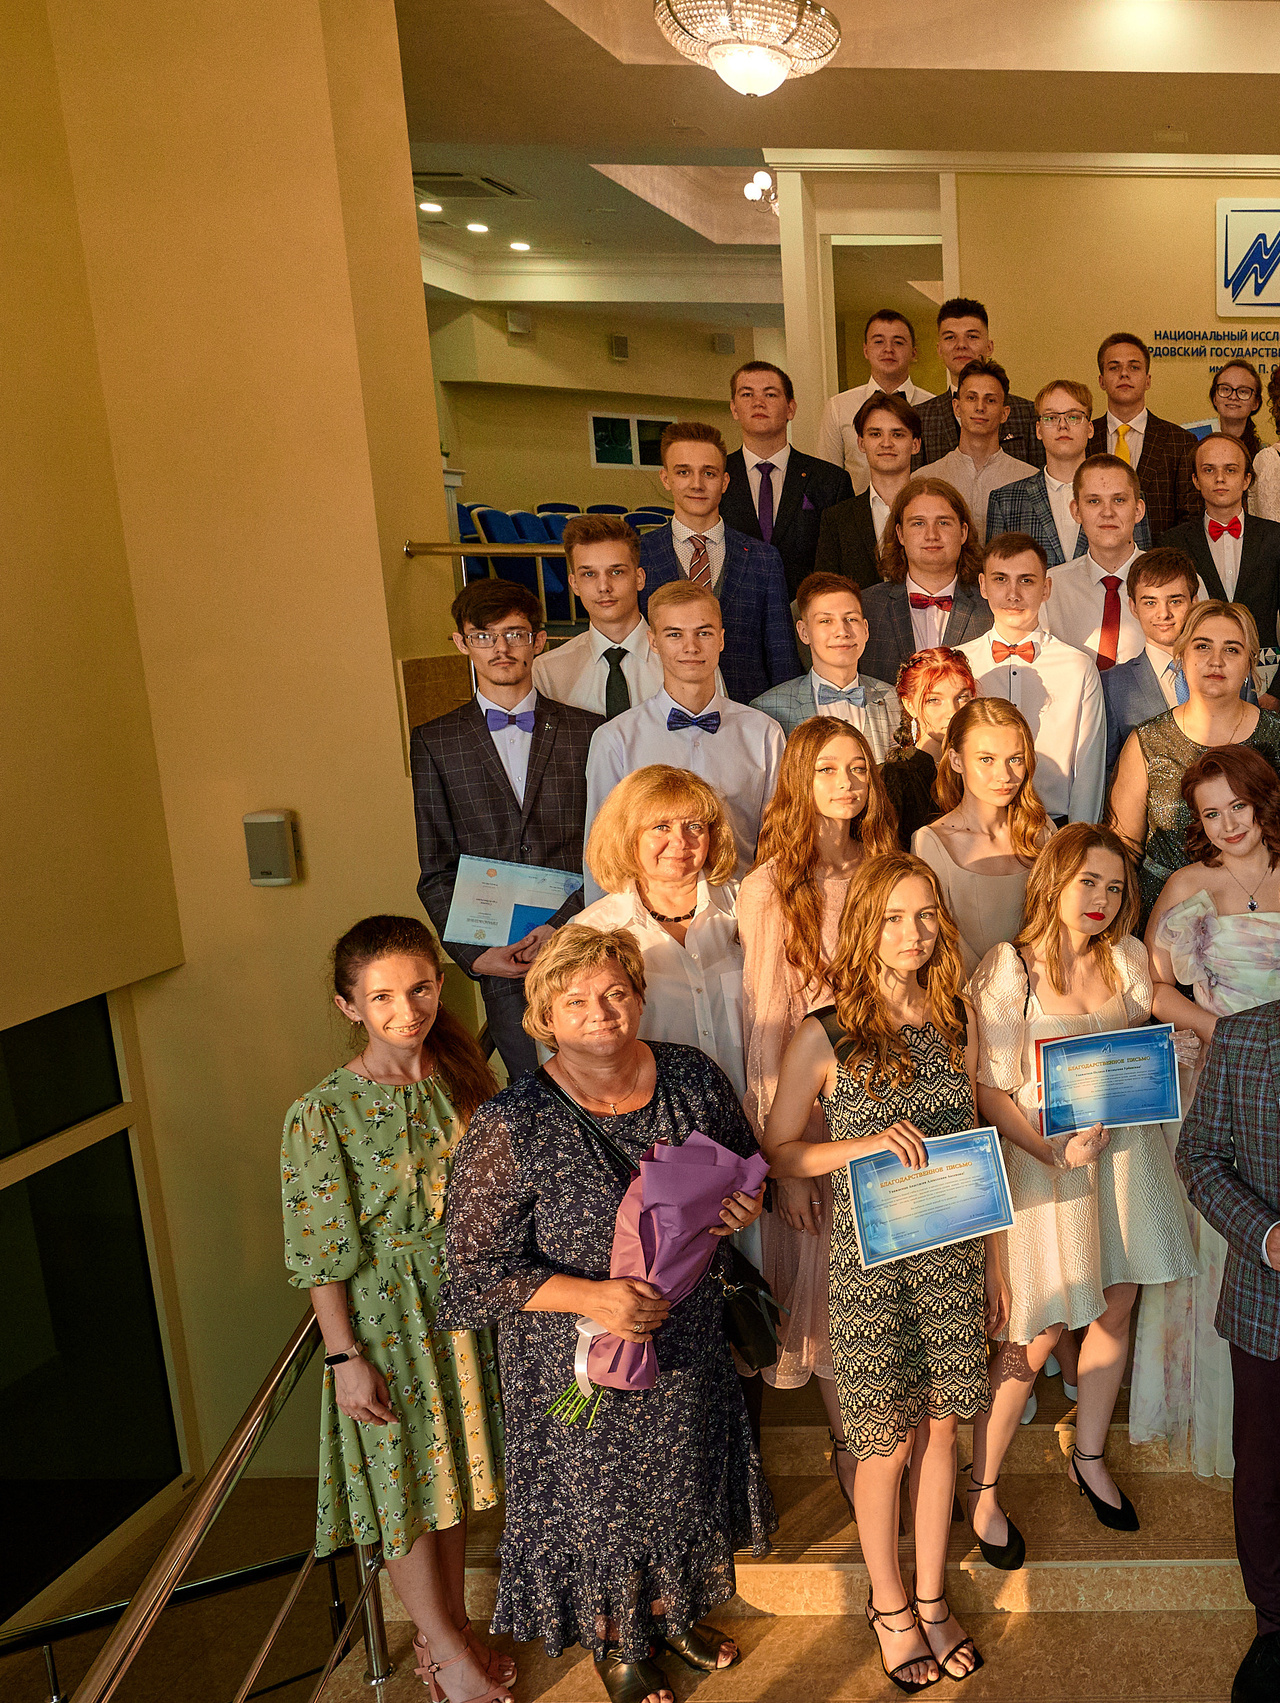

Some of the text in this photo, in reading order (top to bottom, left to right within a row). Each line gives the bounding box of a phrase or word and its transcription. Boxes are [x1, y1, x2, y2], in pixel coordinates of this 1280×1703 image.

[1154, 329, 1248, 342] НАЦИОНАЛЬНЫЙ
[880, 1167, 944, 1188] БЛАГОДАРСТВЕННОЕ
[946, 1161, 973, 1171] ПИСЬМО
